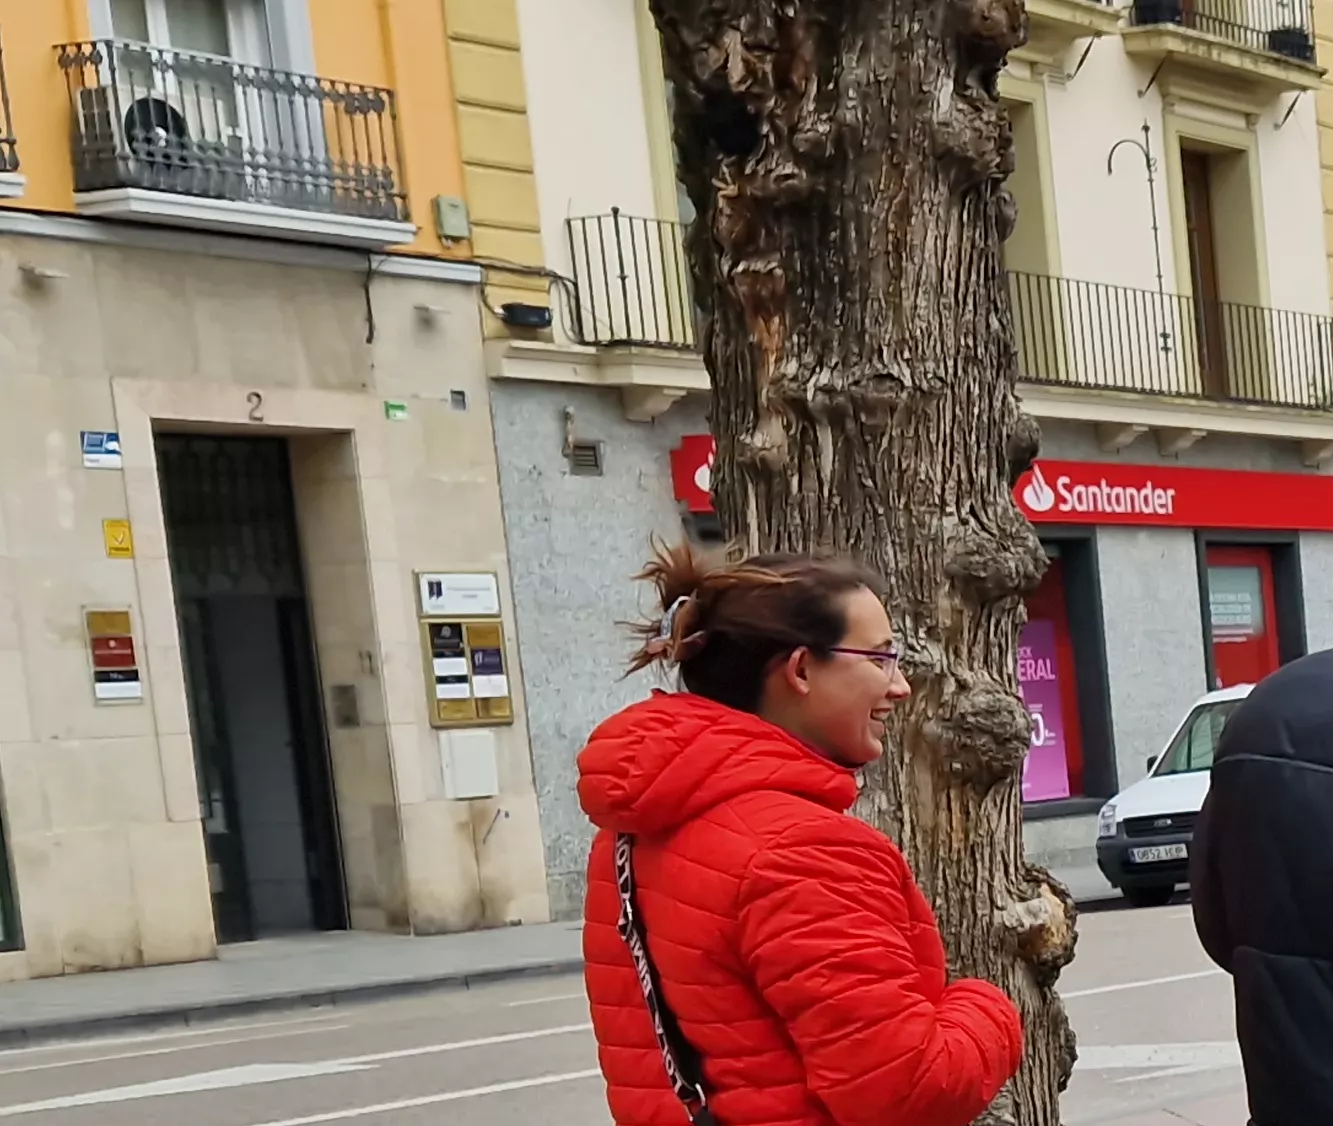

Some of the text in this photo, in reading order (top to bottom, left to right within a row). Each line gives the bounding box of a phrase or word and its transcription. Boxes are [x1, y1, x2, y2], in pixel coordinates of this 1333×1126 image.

[246, 391, 265, 421] 2
[1058, 475, 1176, 515] Santander
[1017, 658, 1056, 681] ERAL
